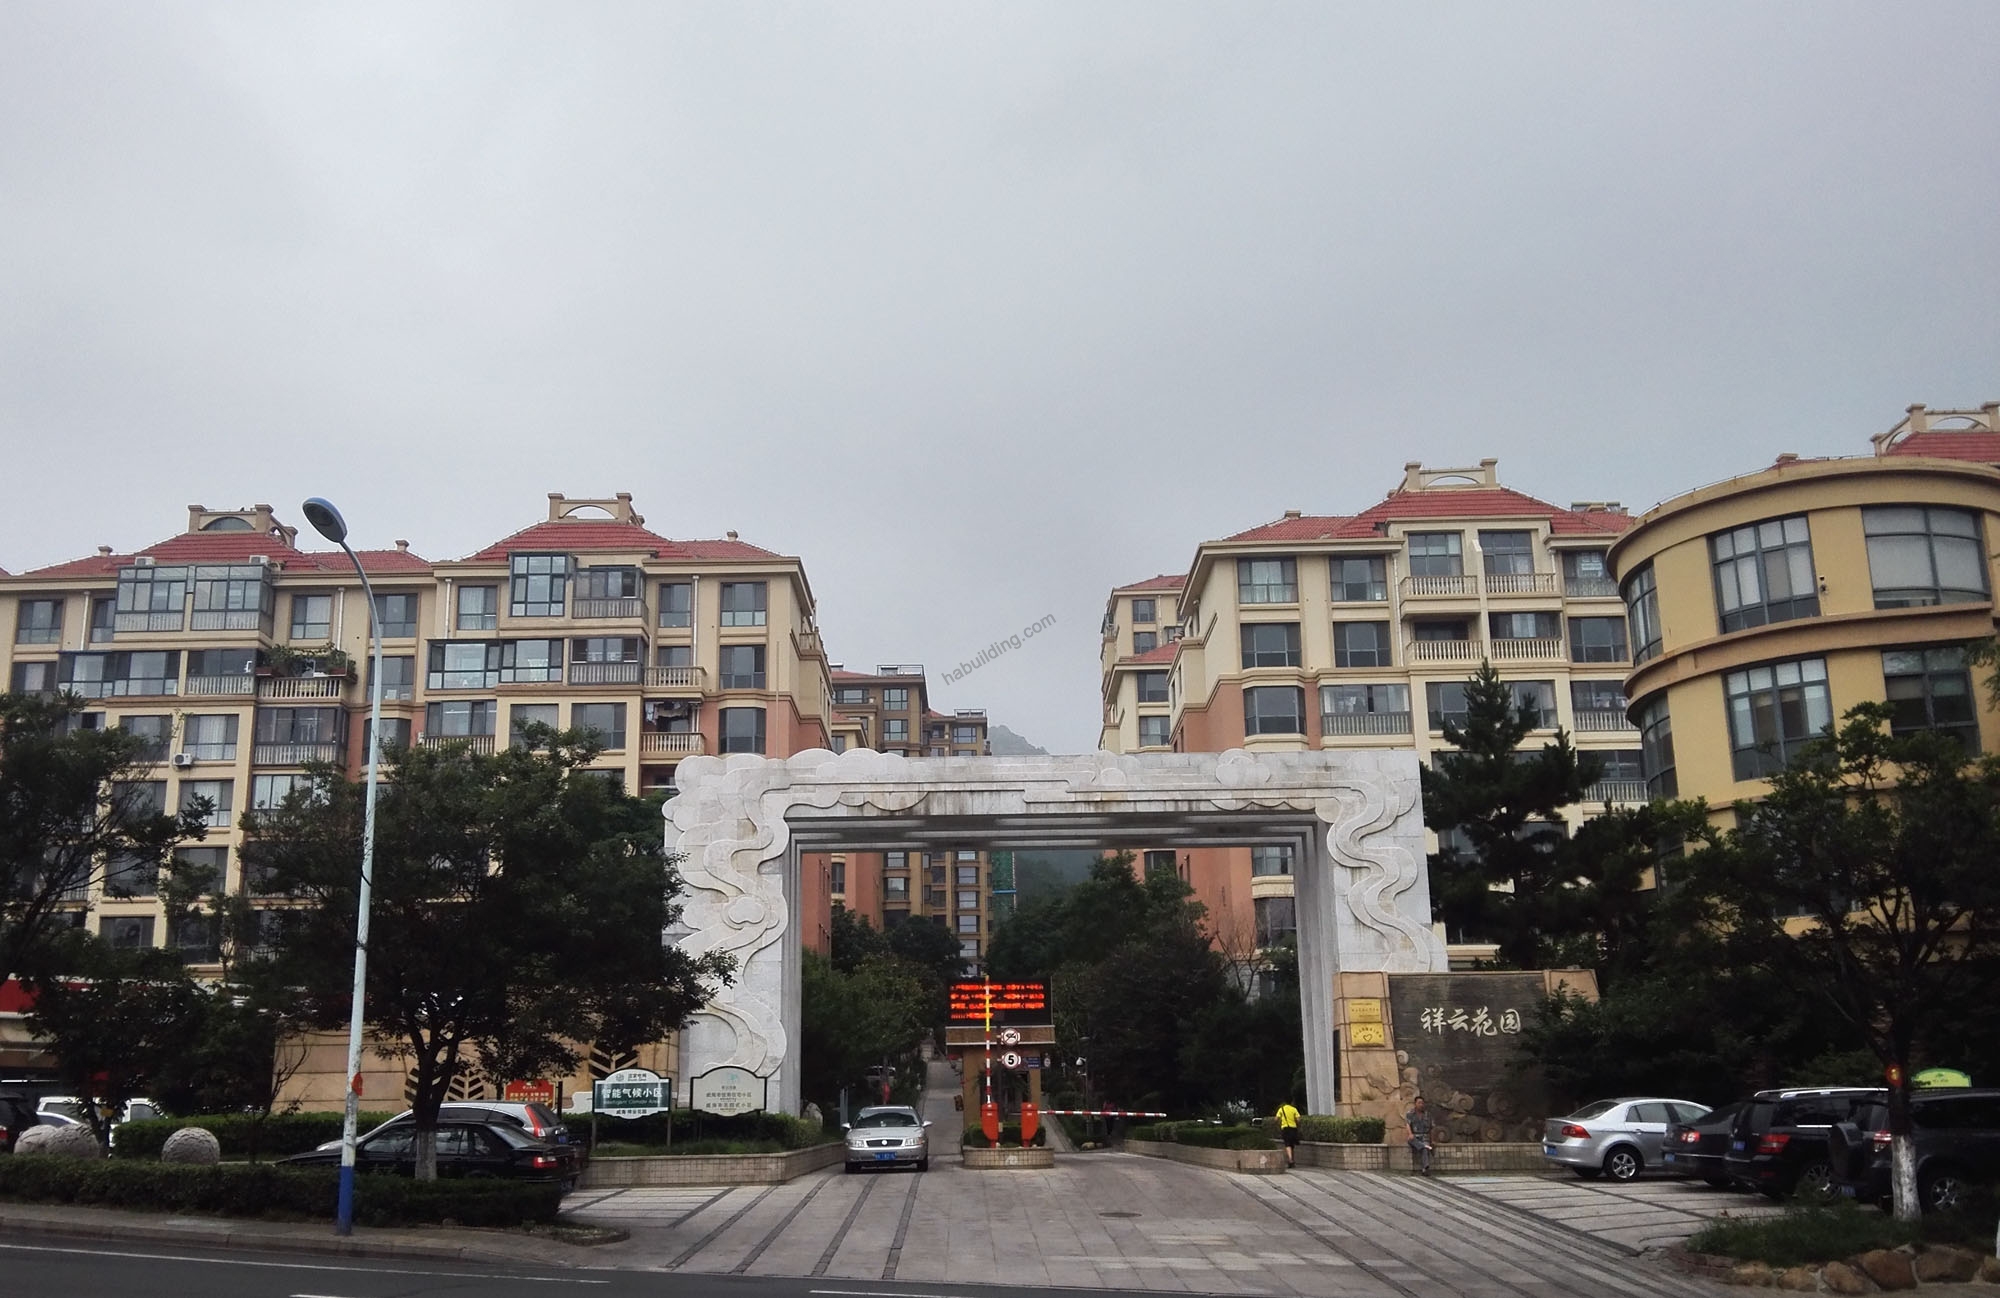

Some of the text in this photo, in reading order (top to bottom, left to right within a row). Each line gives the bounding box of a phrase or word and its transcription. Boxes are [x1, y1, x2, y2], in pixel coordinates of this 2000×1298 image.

[1420, 1006, 1521, 1037] 祥云花园
[1008, 1055, 1015, 1065] 5
[601, 1087, 663, 1099] 智能气候小区
